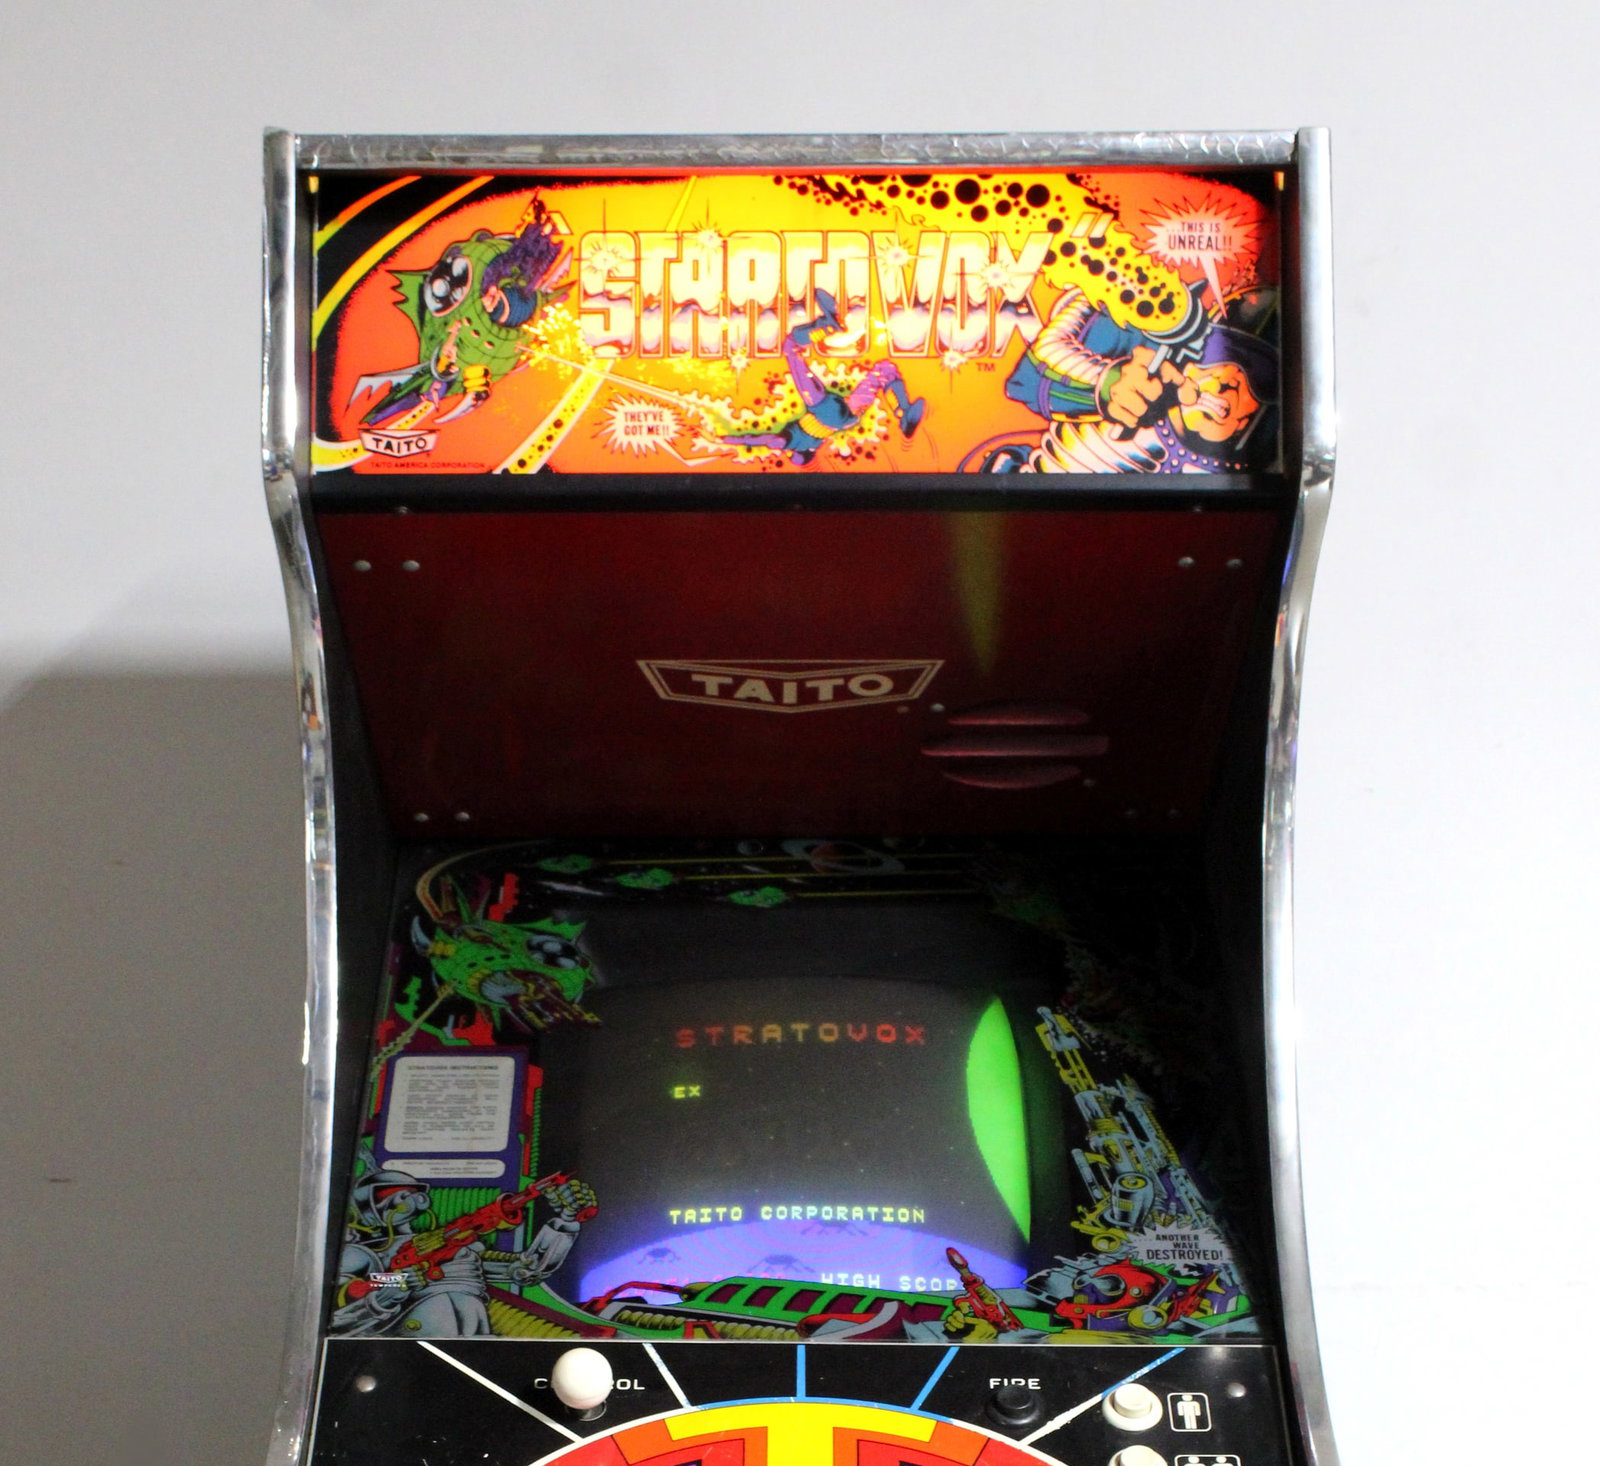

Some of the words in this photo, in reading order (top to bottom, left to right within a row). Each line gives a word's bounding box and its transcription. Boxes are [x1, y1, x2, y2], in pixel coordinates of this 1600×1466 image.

[1210, 222, 1221, 232] IS
[1168, 234, 1232, 251] UNREAL!!
[578, 229, 1055, 359] STRATOVOX
[976, 362, 996, 372] TM
[624, 411, 664, 422] THEY'VE
[624, 425, 643, 436] GOT
[647, 425, 670, 436] ME!!
[372, 437, 427, 454] TAITO
[691, 673, 894, 704] TAITO
[675, 1023, 925, 1048] STRATOVOX
[673, 1085, 701, 1099] EX
[669, 1206, 743, 1225] TAITO
[761, 1205, 925, 1224] CORPORATION
[1155, 1233, 1199, 1241] ANOTHER
[1173, 1241, 1200, 1250] WAVE
[1146, 1249, 1223, 1261] DESTROYED!
[821, 1273, 880, 1289] HIGH
